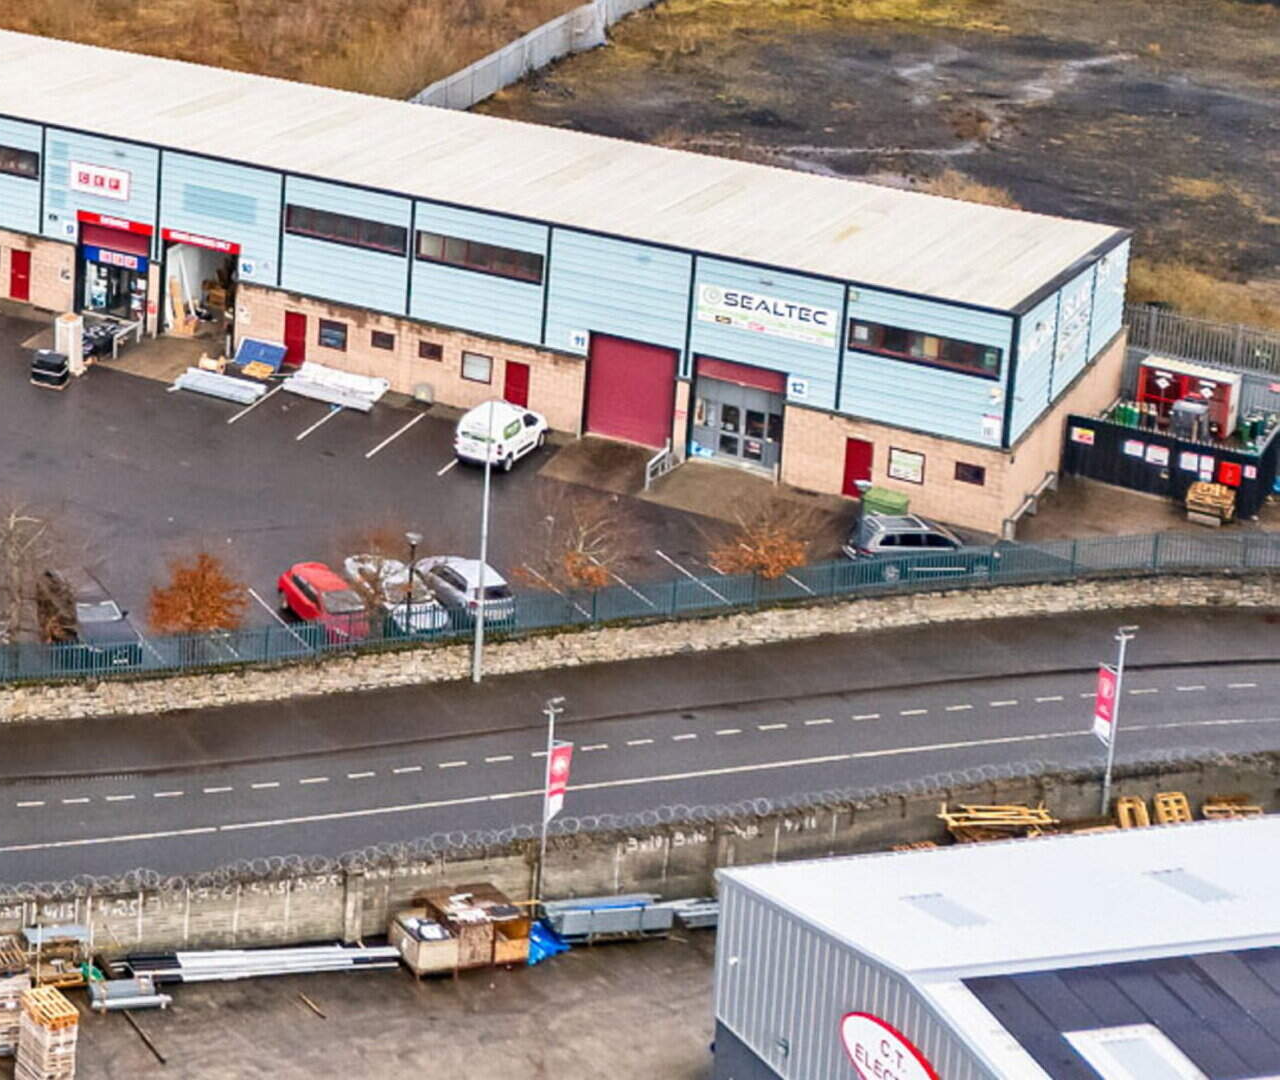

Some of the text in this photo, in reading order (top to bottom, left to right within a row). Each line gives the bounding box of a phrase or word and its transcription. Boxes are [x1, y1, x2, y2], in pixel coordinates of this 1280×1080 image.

[724, 292, 828, 325] SEALTEC
[791, 381, 804, 394] 12
[881, 1040, 907, 1072] C.T.
